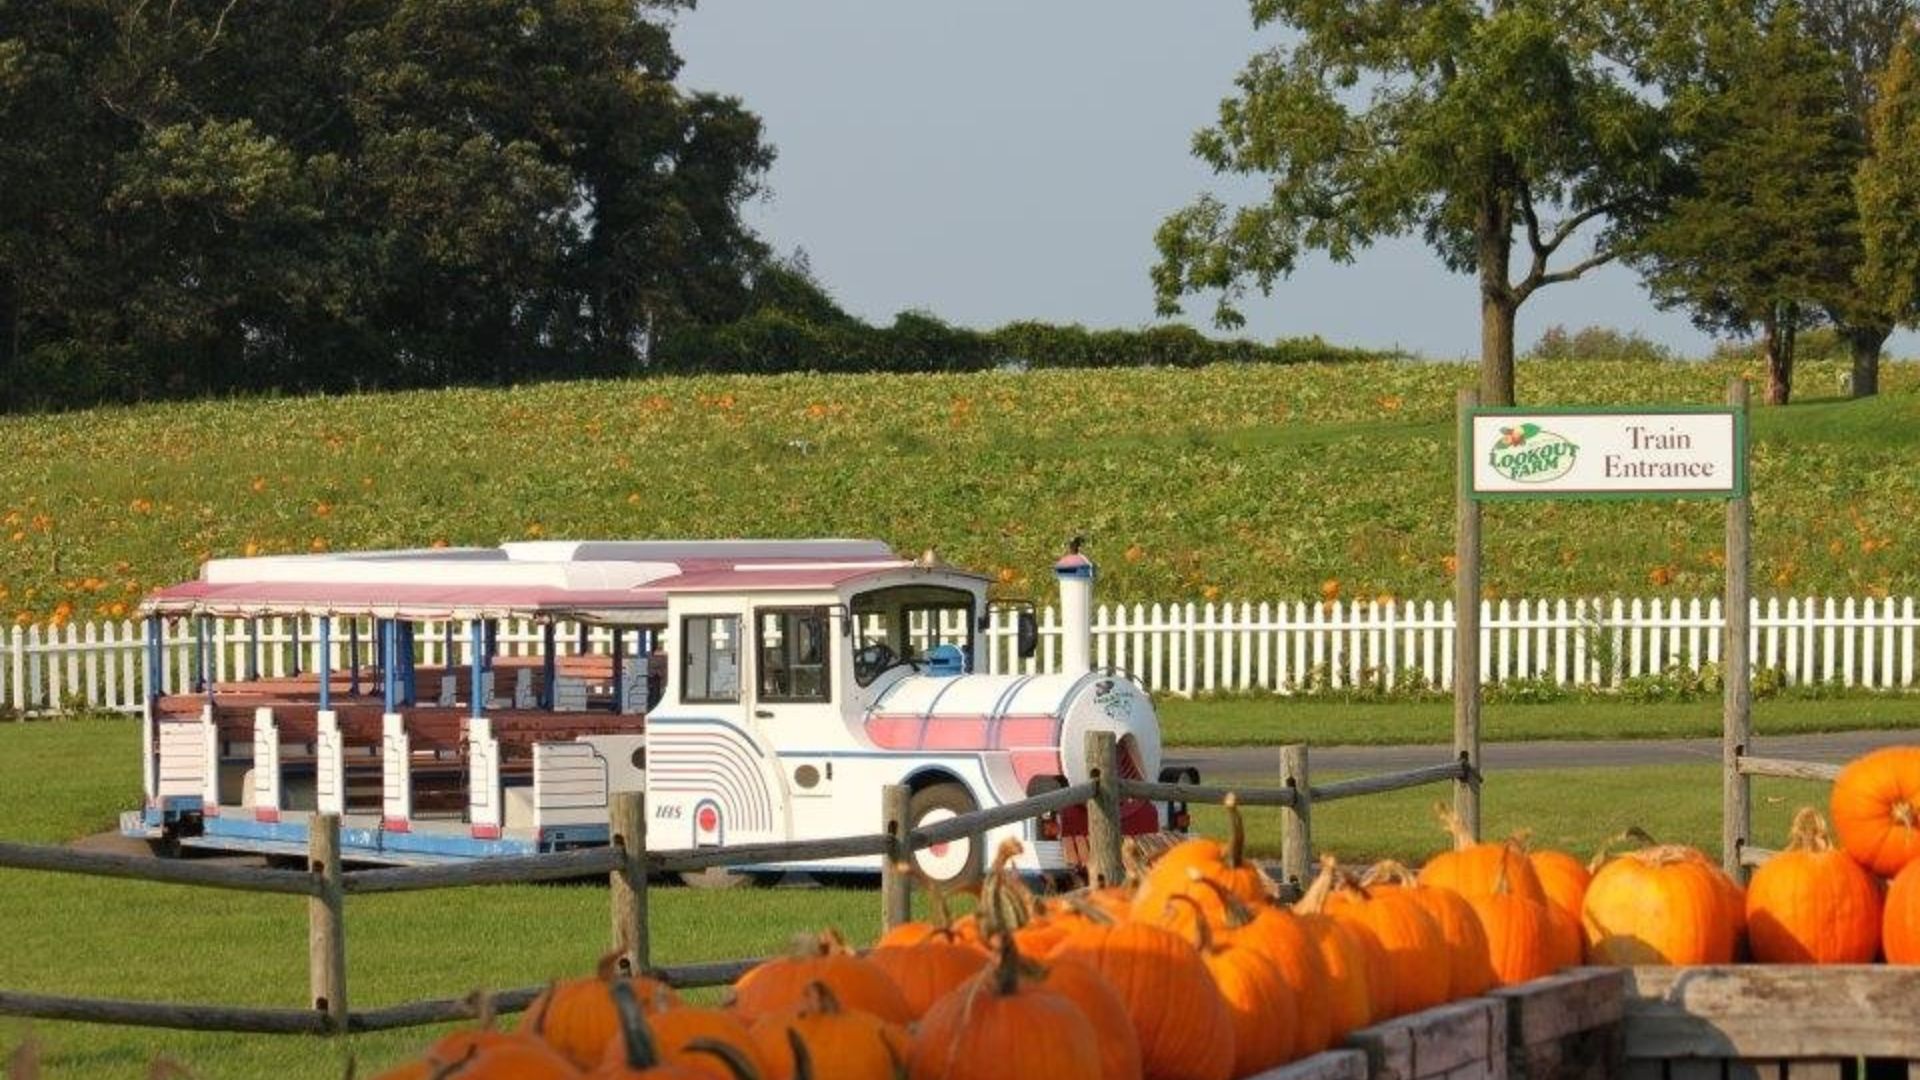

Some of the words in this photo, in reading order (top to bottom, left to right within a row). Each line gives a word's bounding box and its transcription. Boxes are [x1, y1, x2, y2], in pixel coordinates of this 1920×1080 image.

[1625, 426, 1691, 449] Train
[1489, 443, 1580, 467] LOOKOUT
[1604, 455, 1714, 478] Entrance
[1511, 457, 1558, 479] FARM
